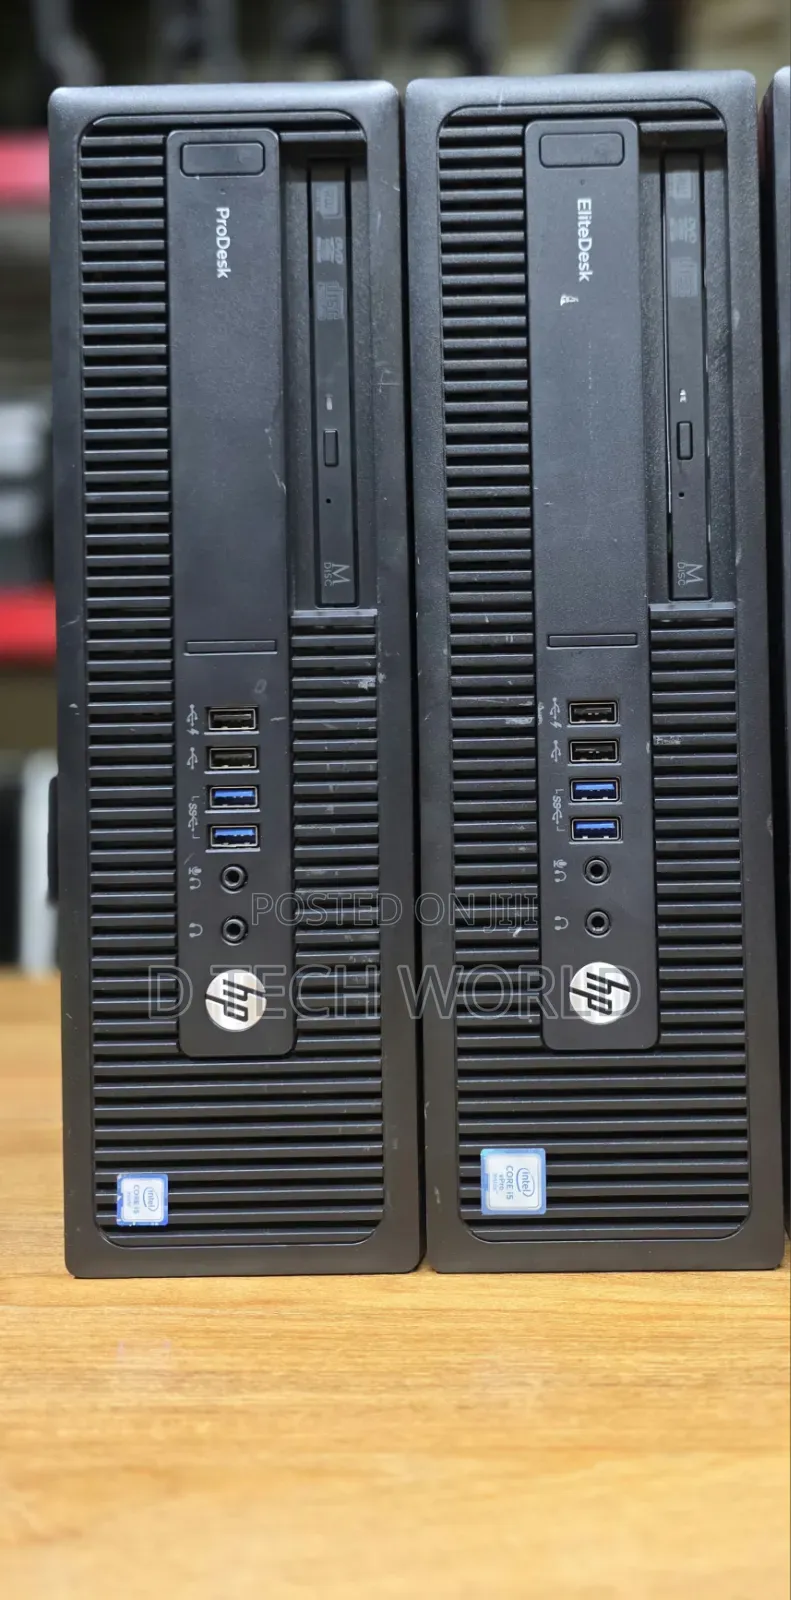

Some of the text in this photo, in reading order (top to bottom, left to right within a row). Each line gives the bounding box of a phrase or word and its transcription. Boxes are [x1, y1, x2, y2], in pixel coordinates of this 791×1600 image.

[215, 206, 231, 279] ProDesk
[577, 198, 593, 282] EliteDesk
[323, 562, 332, 587] DISC
[332, 563, 351, 585] M
[677, 562, 685, 587] DISC
[685, 563, 704, 585] M
[205, 976, 266, 1024] hp
[569, 970, 631, 1017] hp
[506, 1165, 514, 1189] CORE
